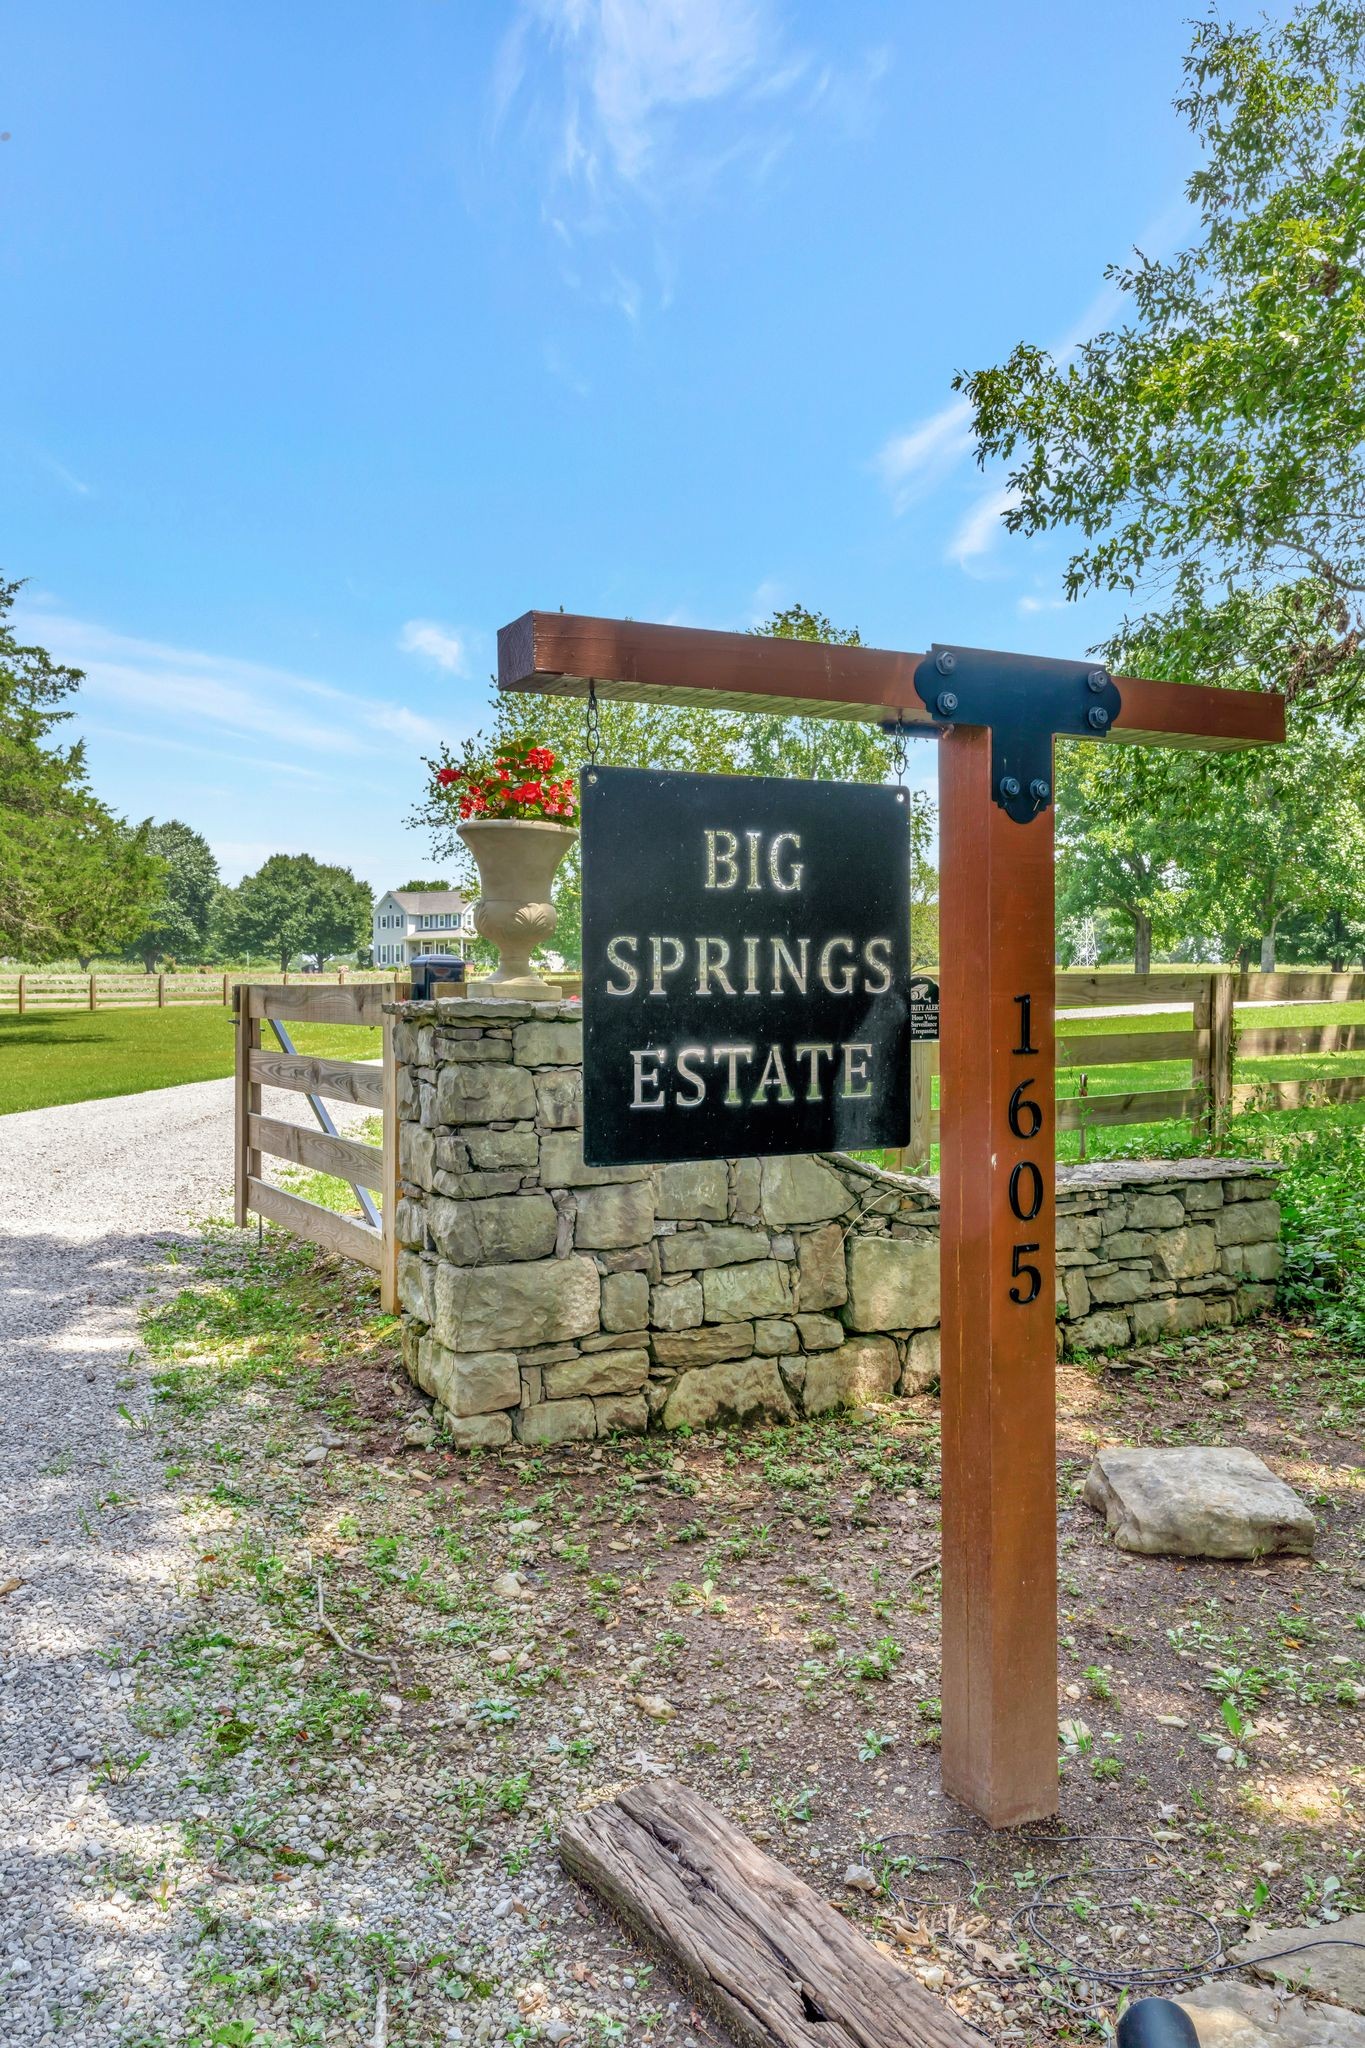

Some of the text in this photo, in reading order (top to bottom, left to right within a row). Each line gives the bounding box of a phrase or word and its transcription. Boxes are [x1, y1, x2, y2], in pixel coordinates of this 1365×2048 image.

[704, 830, 804, 890] BIG
[606, 936, 891, 995] SPRINGS
[629, 1044, 873, 1107] ESTATE
[1008, 994, 1043, 1305] 1605
